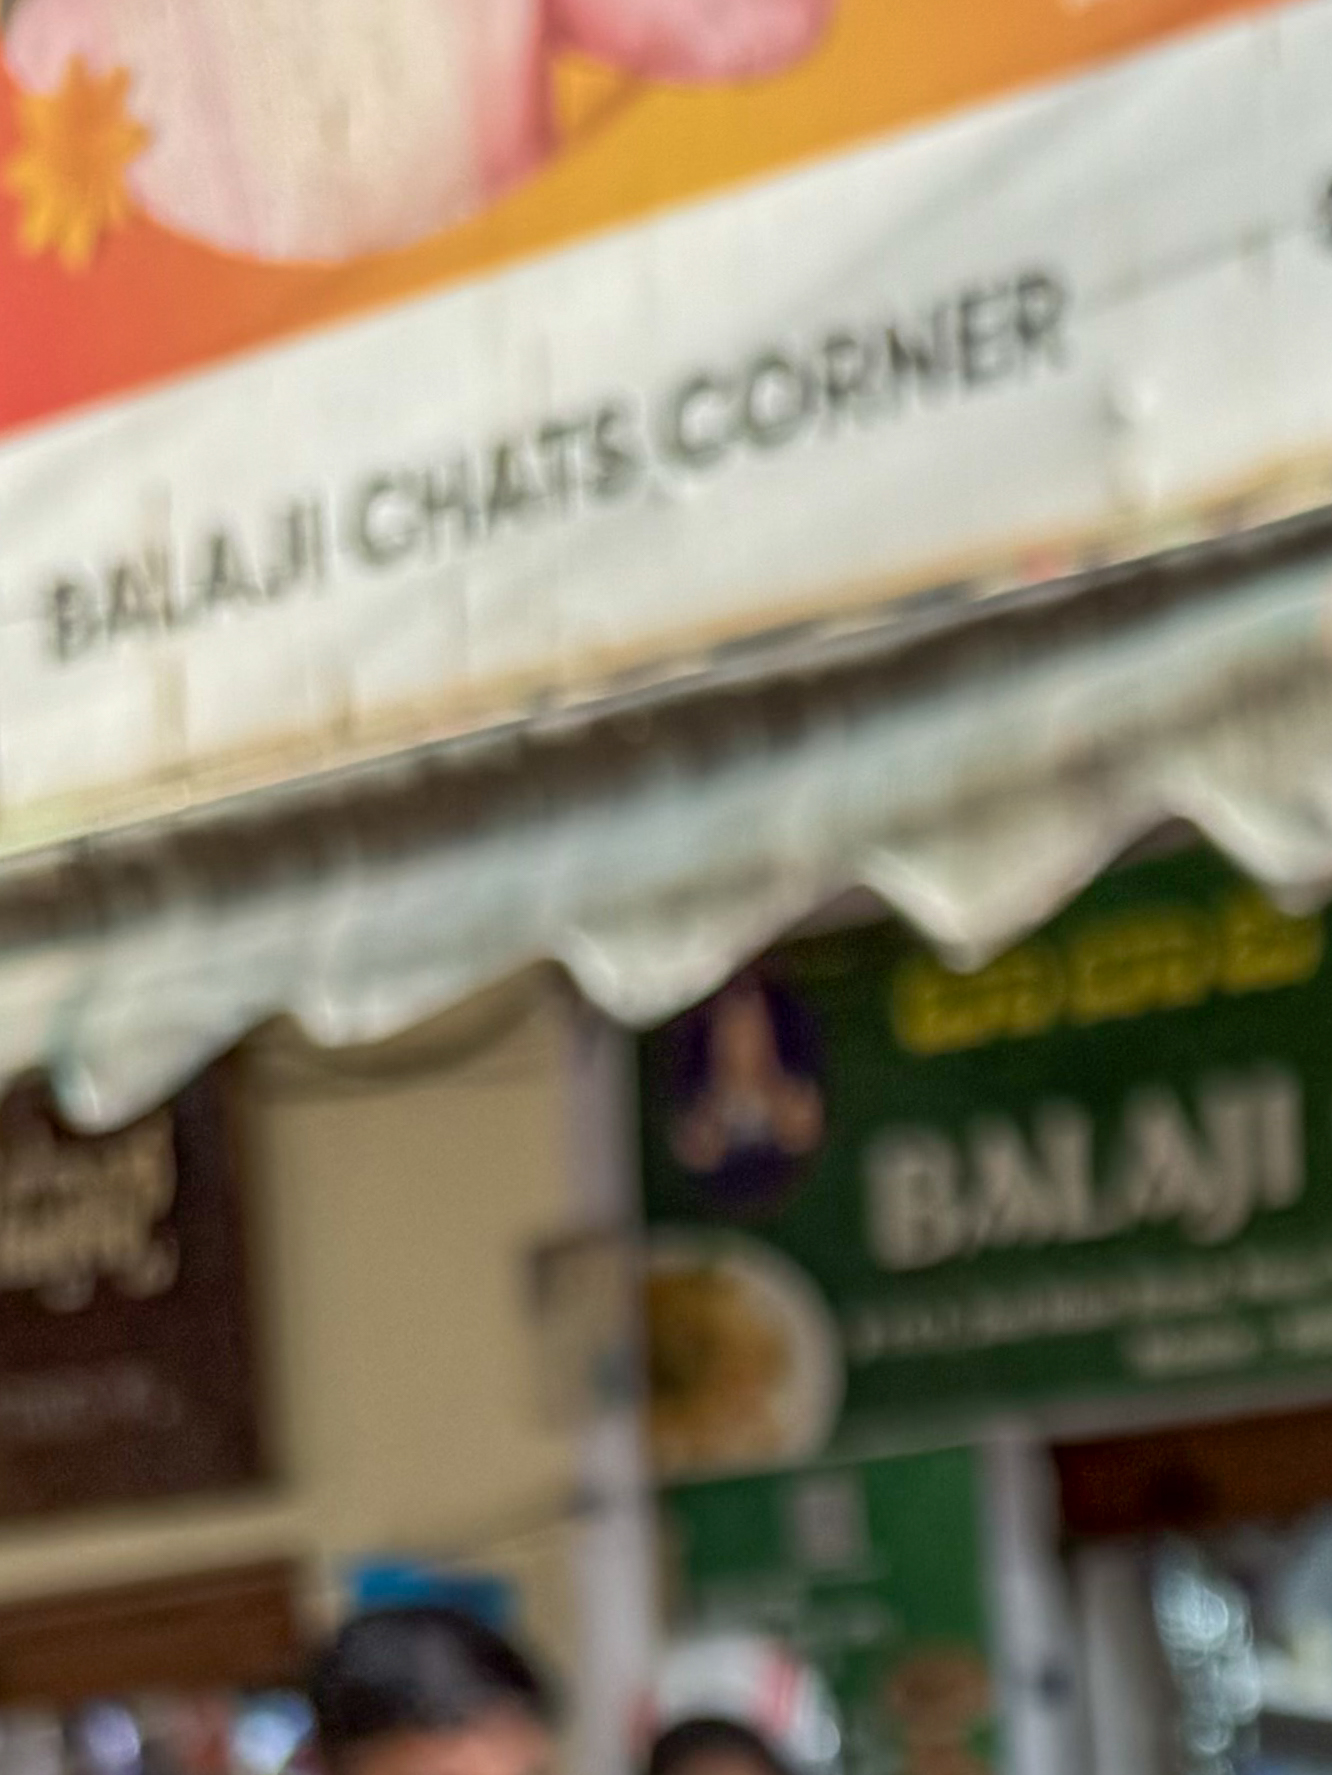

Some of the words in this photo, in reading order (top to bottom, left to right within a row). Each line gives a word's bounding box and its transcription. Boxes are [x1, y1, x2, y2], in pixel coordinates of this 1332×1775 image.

[42, 512, 325, 668] BALAJI
[352, 402, 640, 568] CHATS
[655, 268, 1076, 476] CORNER
[858, 1068, 1308, 1274] BALAJI
